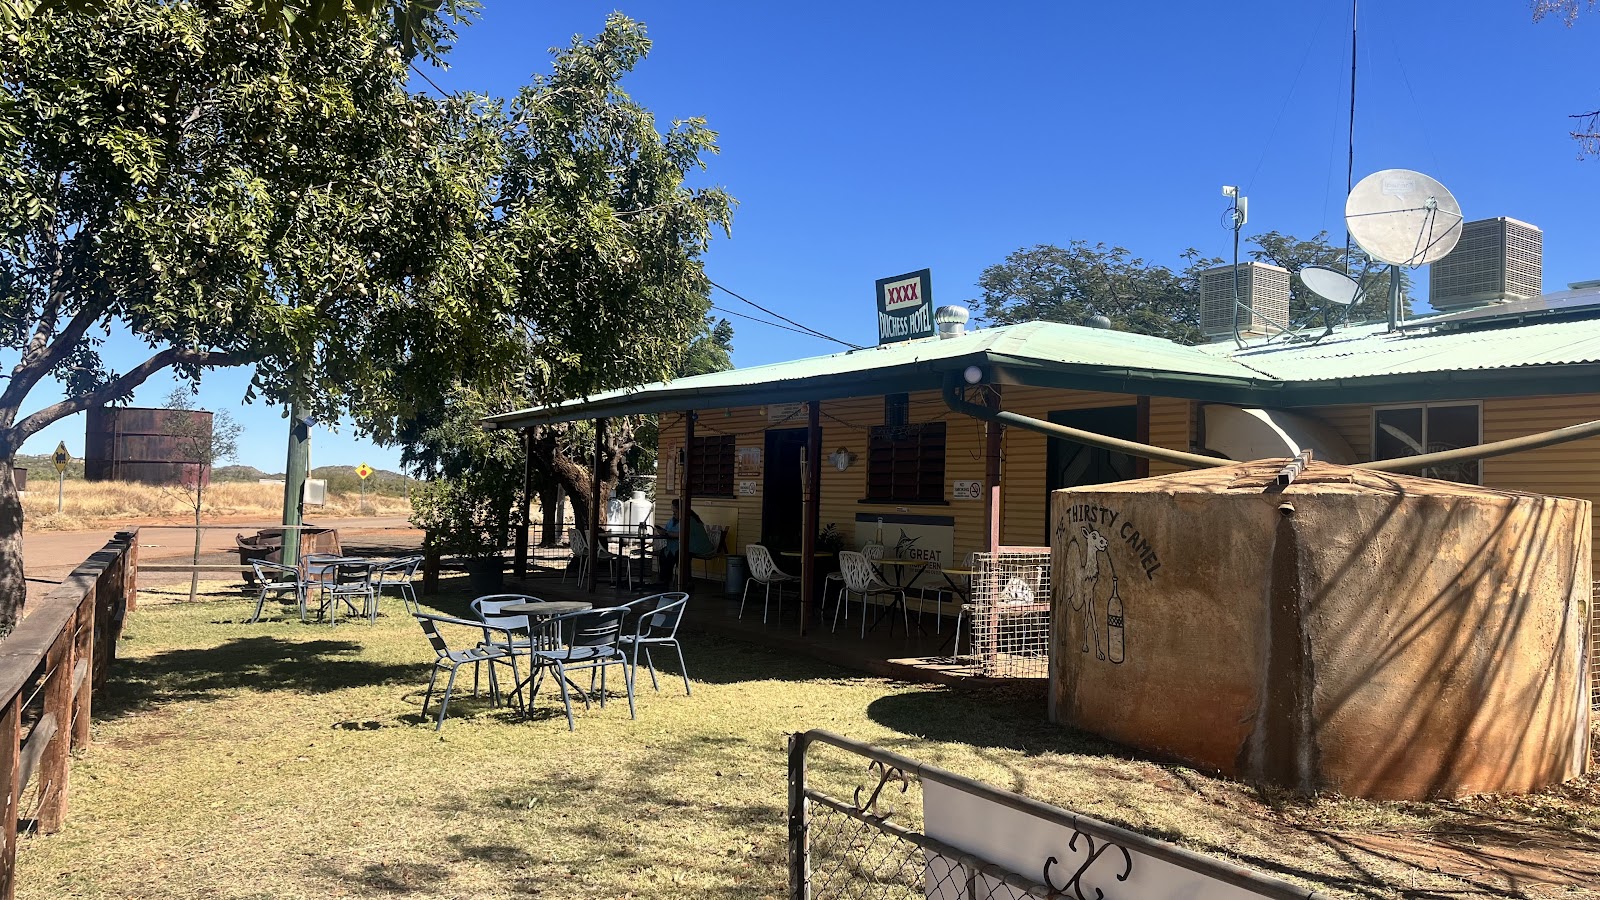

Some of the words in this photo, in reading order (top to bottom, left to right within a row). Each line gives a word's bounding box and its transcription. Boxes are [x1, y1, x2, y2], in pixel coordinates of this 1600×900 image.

[887, 282, 919, 305] XXXX
[878, 310, 909, 339] DUCHESS
[909, 302, 932, 334] HOTEL
[909, 548, 942, 561] GREAT
[1066, 504, 1120, 528] THIRSTY
[1120, 521, 1162, 581] CAMEL
